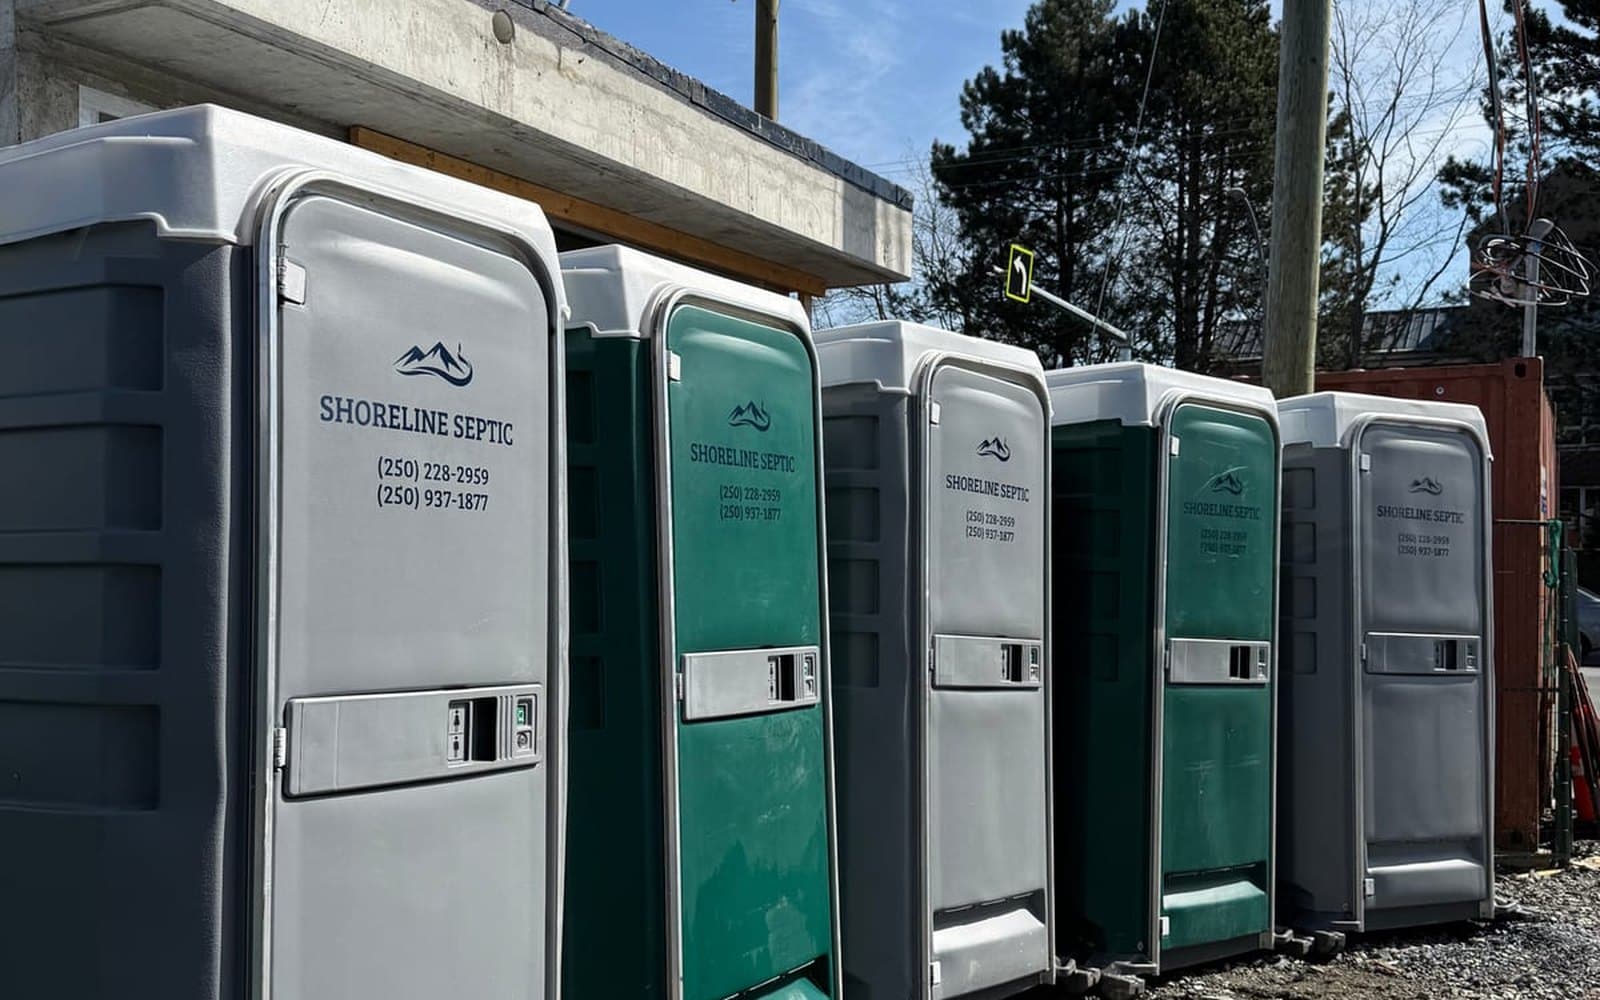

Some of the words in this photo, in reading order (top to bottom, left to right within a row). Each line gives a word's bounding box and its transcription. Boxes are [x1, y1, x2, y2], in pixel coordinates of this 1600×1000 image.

[320, 395, 448, 435] SHORELINE
[453, 414, 513, 445] SEPTIC
[378, 456, 419, 482] (250)
[424, 463, 489, 485] 228-2959
[690, 443, 759, 468] SHORELINE
[760, 453, 795, 472] SEPTIC
[377, 484, 420, 510] (250)
[424, 489, 488, 511] 937-1877
[720, 485, 742, 502] (250)
[744, 487, 781, 502] 228-2959
[946, 474, 999, 497] SHORELINE
[1000, 484, 1030, 502] SEPTIC
[720, 504, 743, 521] (250)
[744, 507, 781, 521] 937-1877
[1183, 502, 1233, 517] SHORELINE
[1376, 505, 1432, 521] SHORELINE
[1433, 511, 1464, 524] SEPTIC
